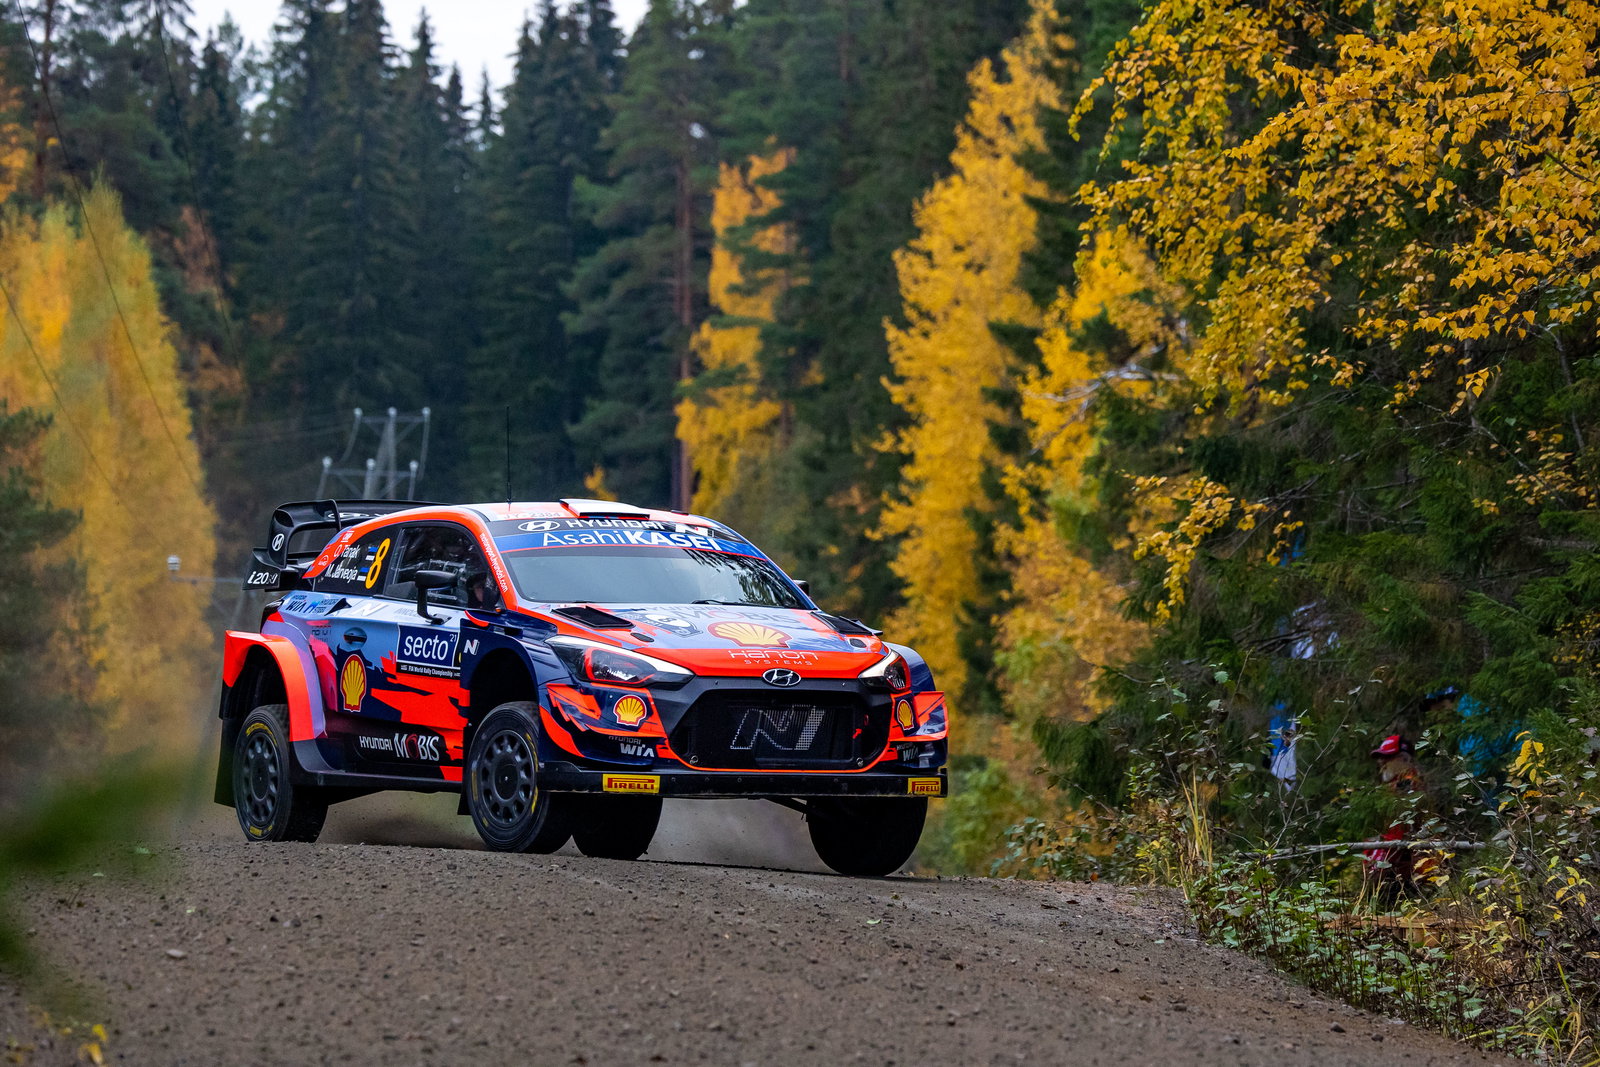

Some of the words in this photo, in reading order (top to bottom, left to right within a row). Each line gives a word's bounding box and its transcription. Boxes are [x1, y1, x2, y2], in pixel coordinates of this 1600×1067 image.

[564, 519, 665, 530] HYUNDAI
[365, 537, 391, 589] 8
[403, 635, 449, 661] secto
[359, 736, 393, 751] HYUNDAI
[393, 733, 440, 762] MOBIS
[607, 778, 655, 790] PIRELLI
